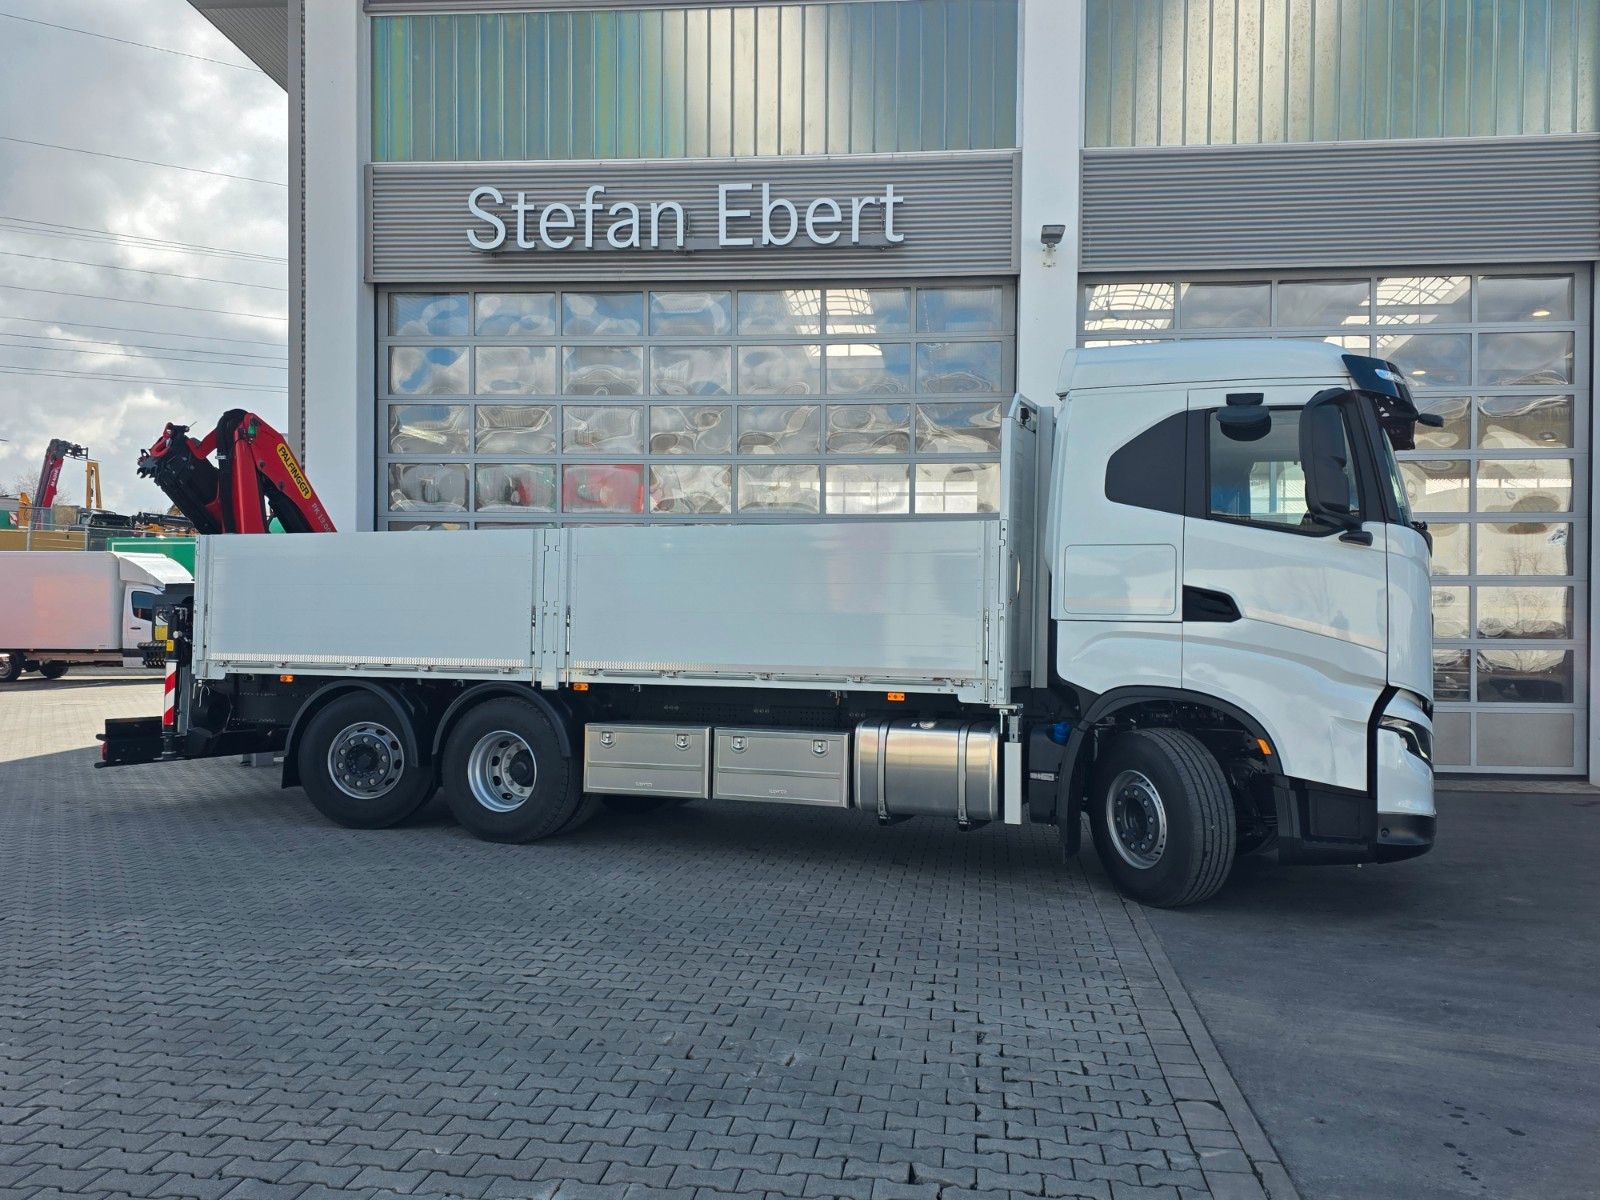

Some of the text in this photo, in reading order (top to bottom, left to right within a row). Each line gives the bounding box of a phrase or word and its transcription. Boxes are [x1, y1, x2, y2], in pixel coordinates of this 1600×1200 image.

[466, 182, 905, 250] Stefan Ebert
[278, 446, 310, 497] PALFINGER
